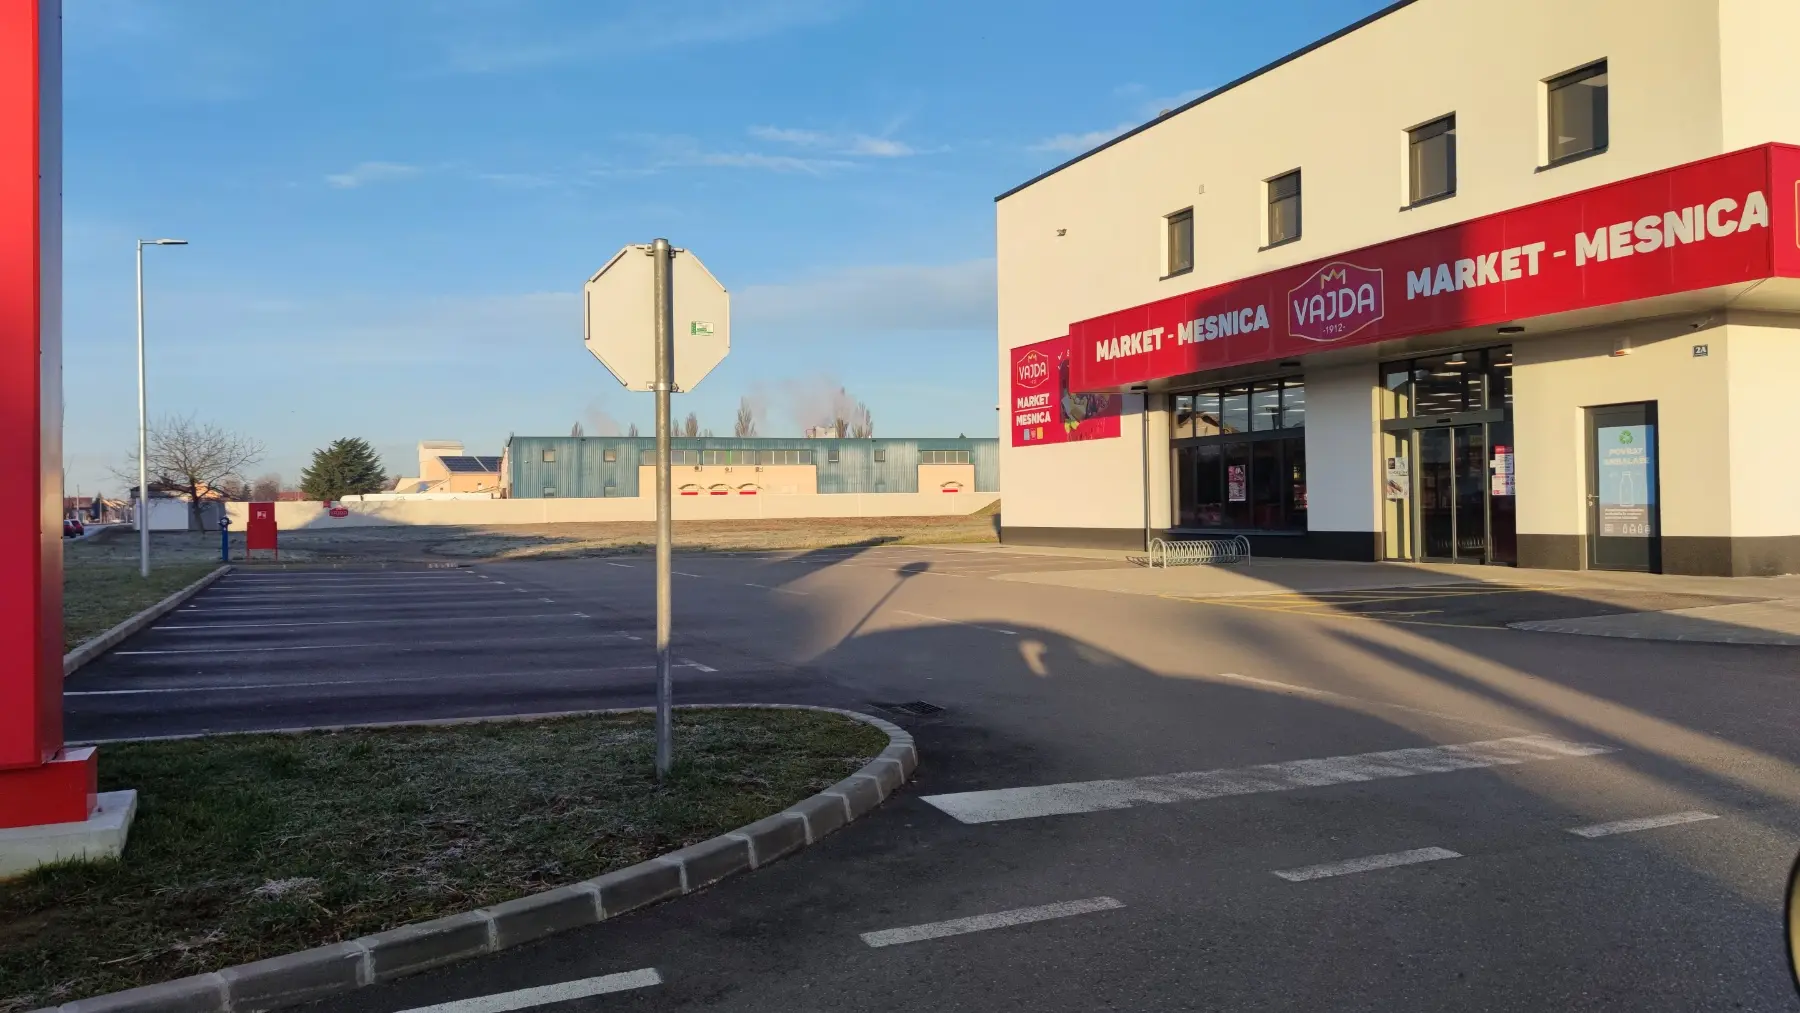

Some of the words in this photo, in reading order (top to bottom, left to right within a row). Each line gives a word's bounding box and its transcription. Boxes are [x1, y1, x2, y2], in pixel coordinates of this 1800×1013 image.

[1406, 241, 1546, 300] MARKET
[1575, 191, 1769, 267] MESNICA
[1293, 283, 1375, 326] VAJDA
[1096, 326, 1165, 362] MARKET
[1177, 304, 1270, 346] MESNICA
[1695, 346, 1707, 354] 2A
[1019, 361, 1047, 380] VAJDA
[1017, 393, 1050, 409] MARKET
[1016, 411, 1051, 426] MESNICA
